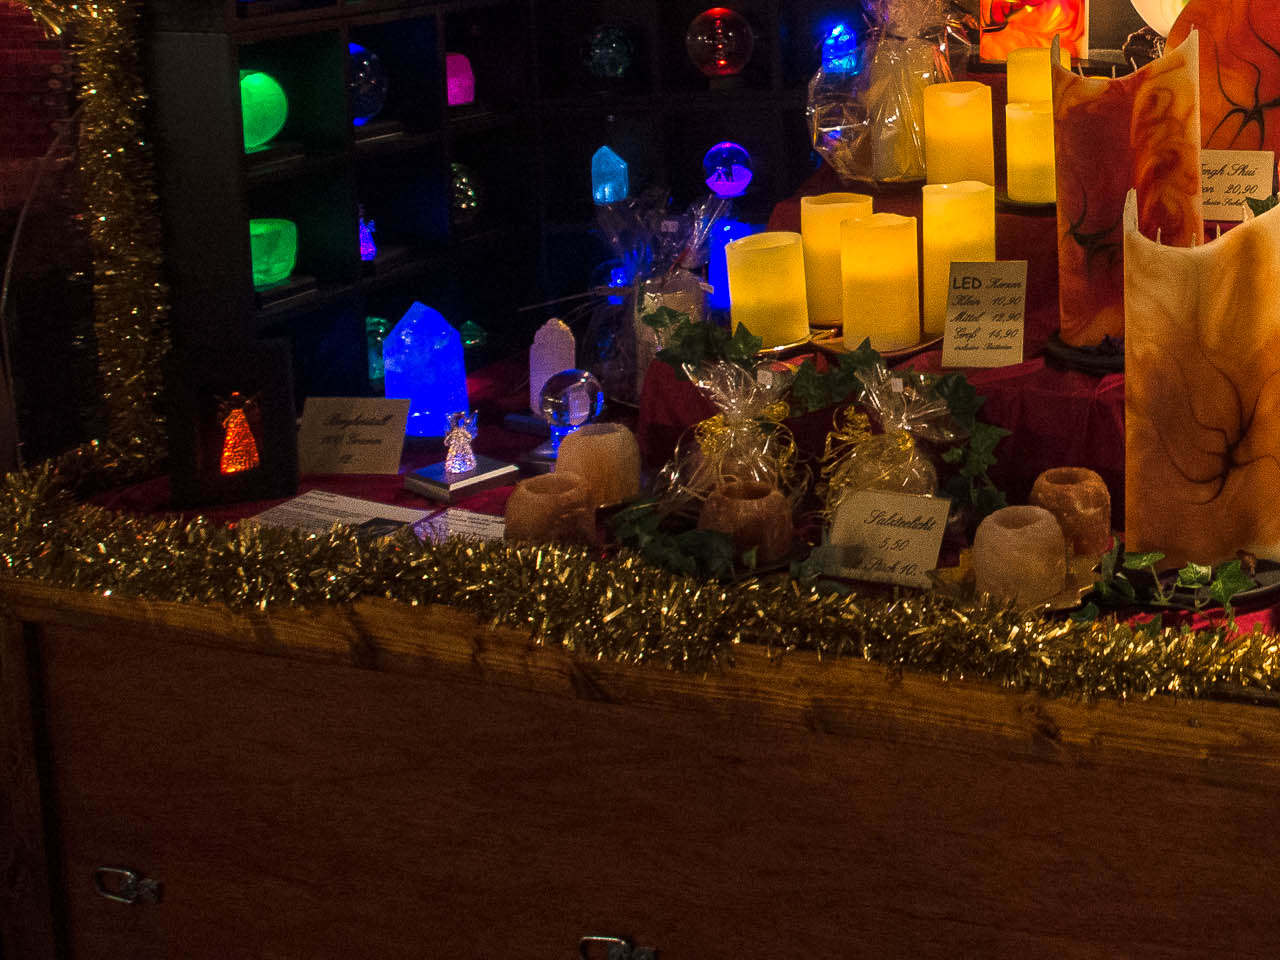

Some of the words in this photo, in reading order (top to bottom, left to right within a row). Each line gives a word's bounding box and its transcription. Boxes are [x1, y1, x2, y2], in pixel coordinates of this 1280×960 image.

[1227, 163, 1258, 177] Shui
[1223, 184, 1259, 196] 20,90
[952, 276, 983, 290] LED
